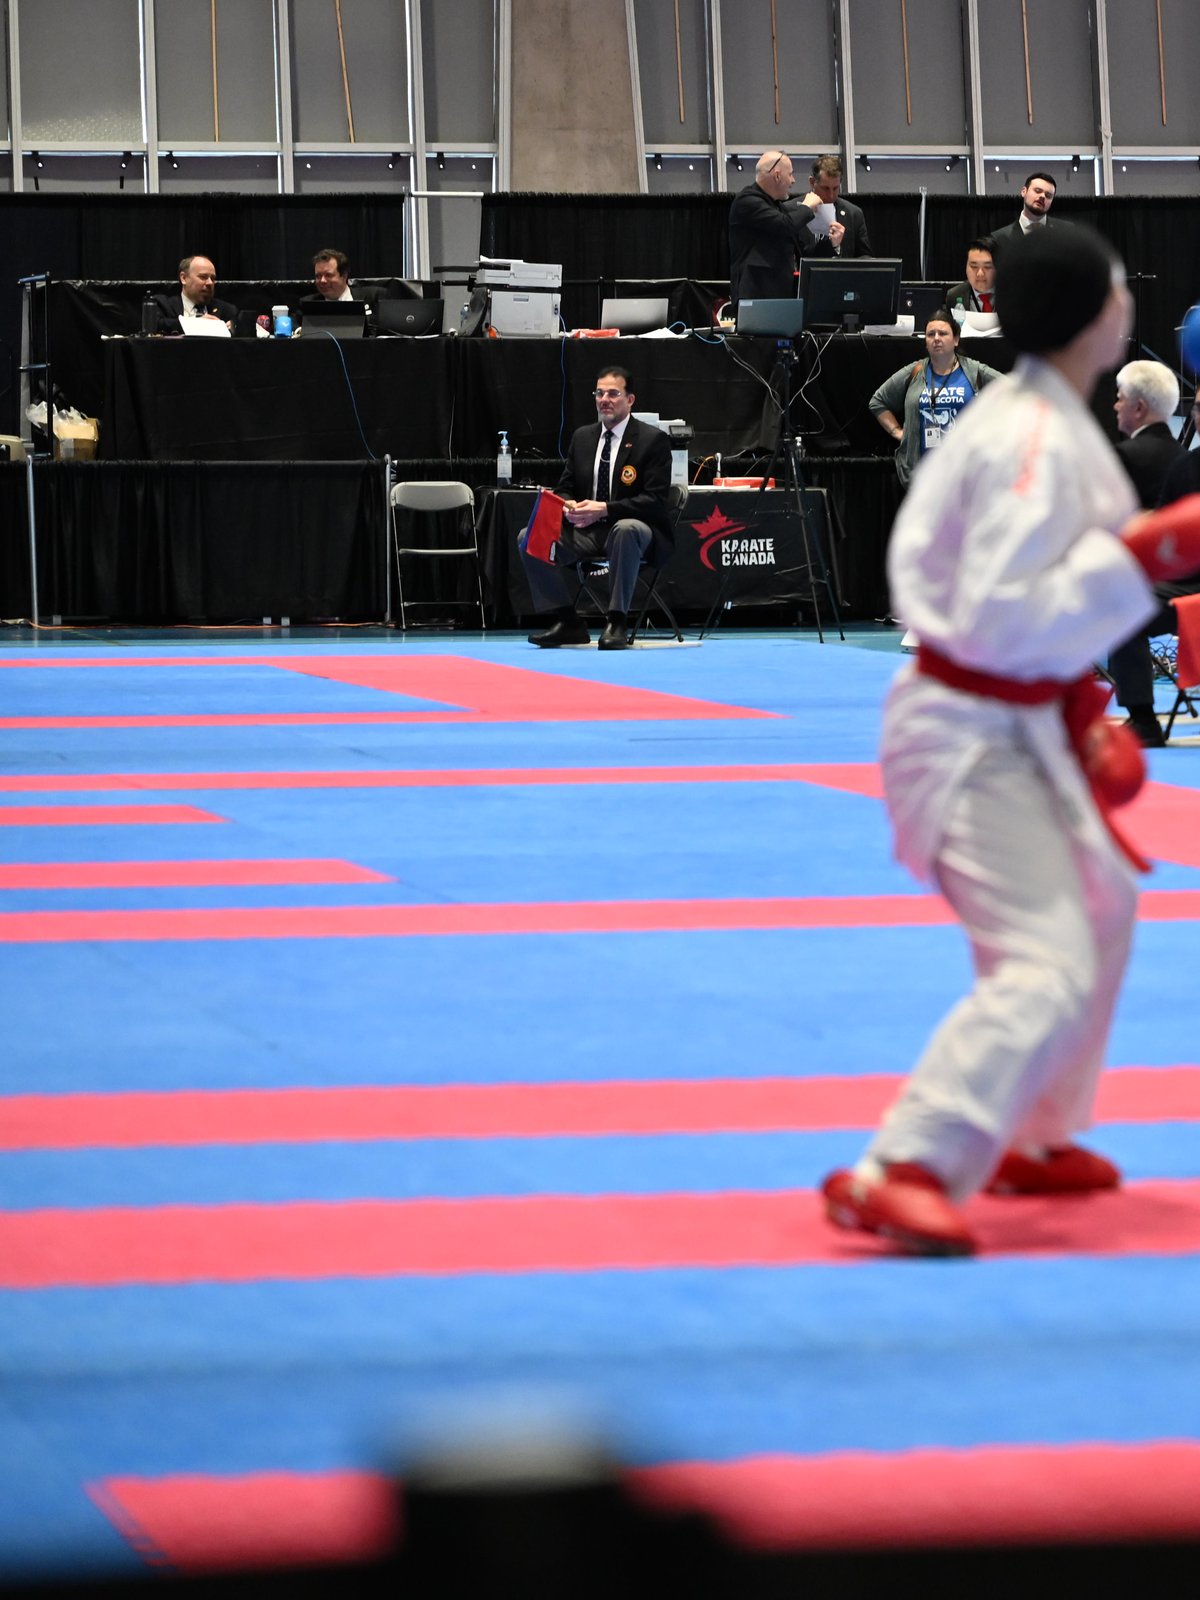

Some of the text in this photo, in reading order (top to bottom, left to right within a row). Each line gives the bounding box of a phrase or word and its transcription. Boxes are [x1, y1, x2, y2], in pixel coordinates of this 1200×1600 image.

[921, 387, 965, 396] ARATE
[721, 538, 775, 553] KARATE
[722, 552, 776, 566] CANADA
